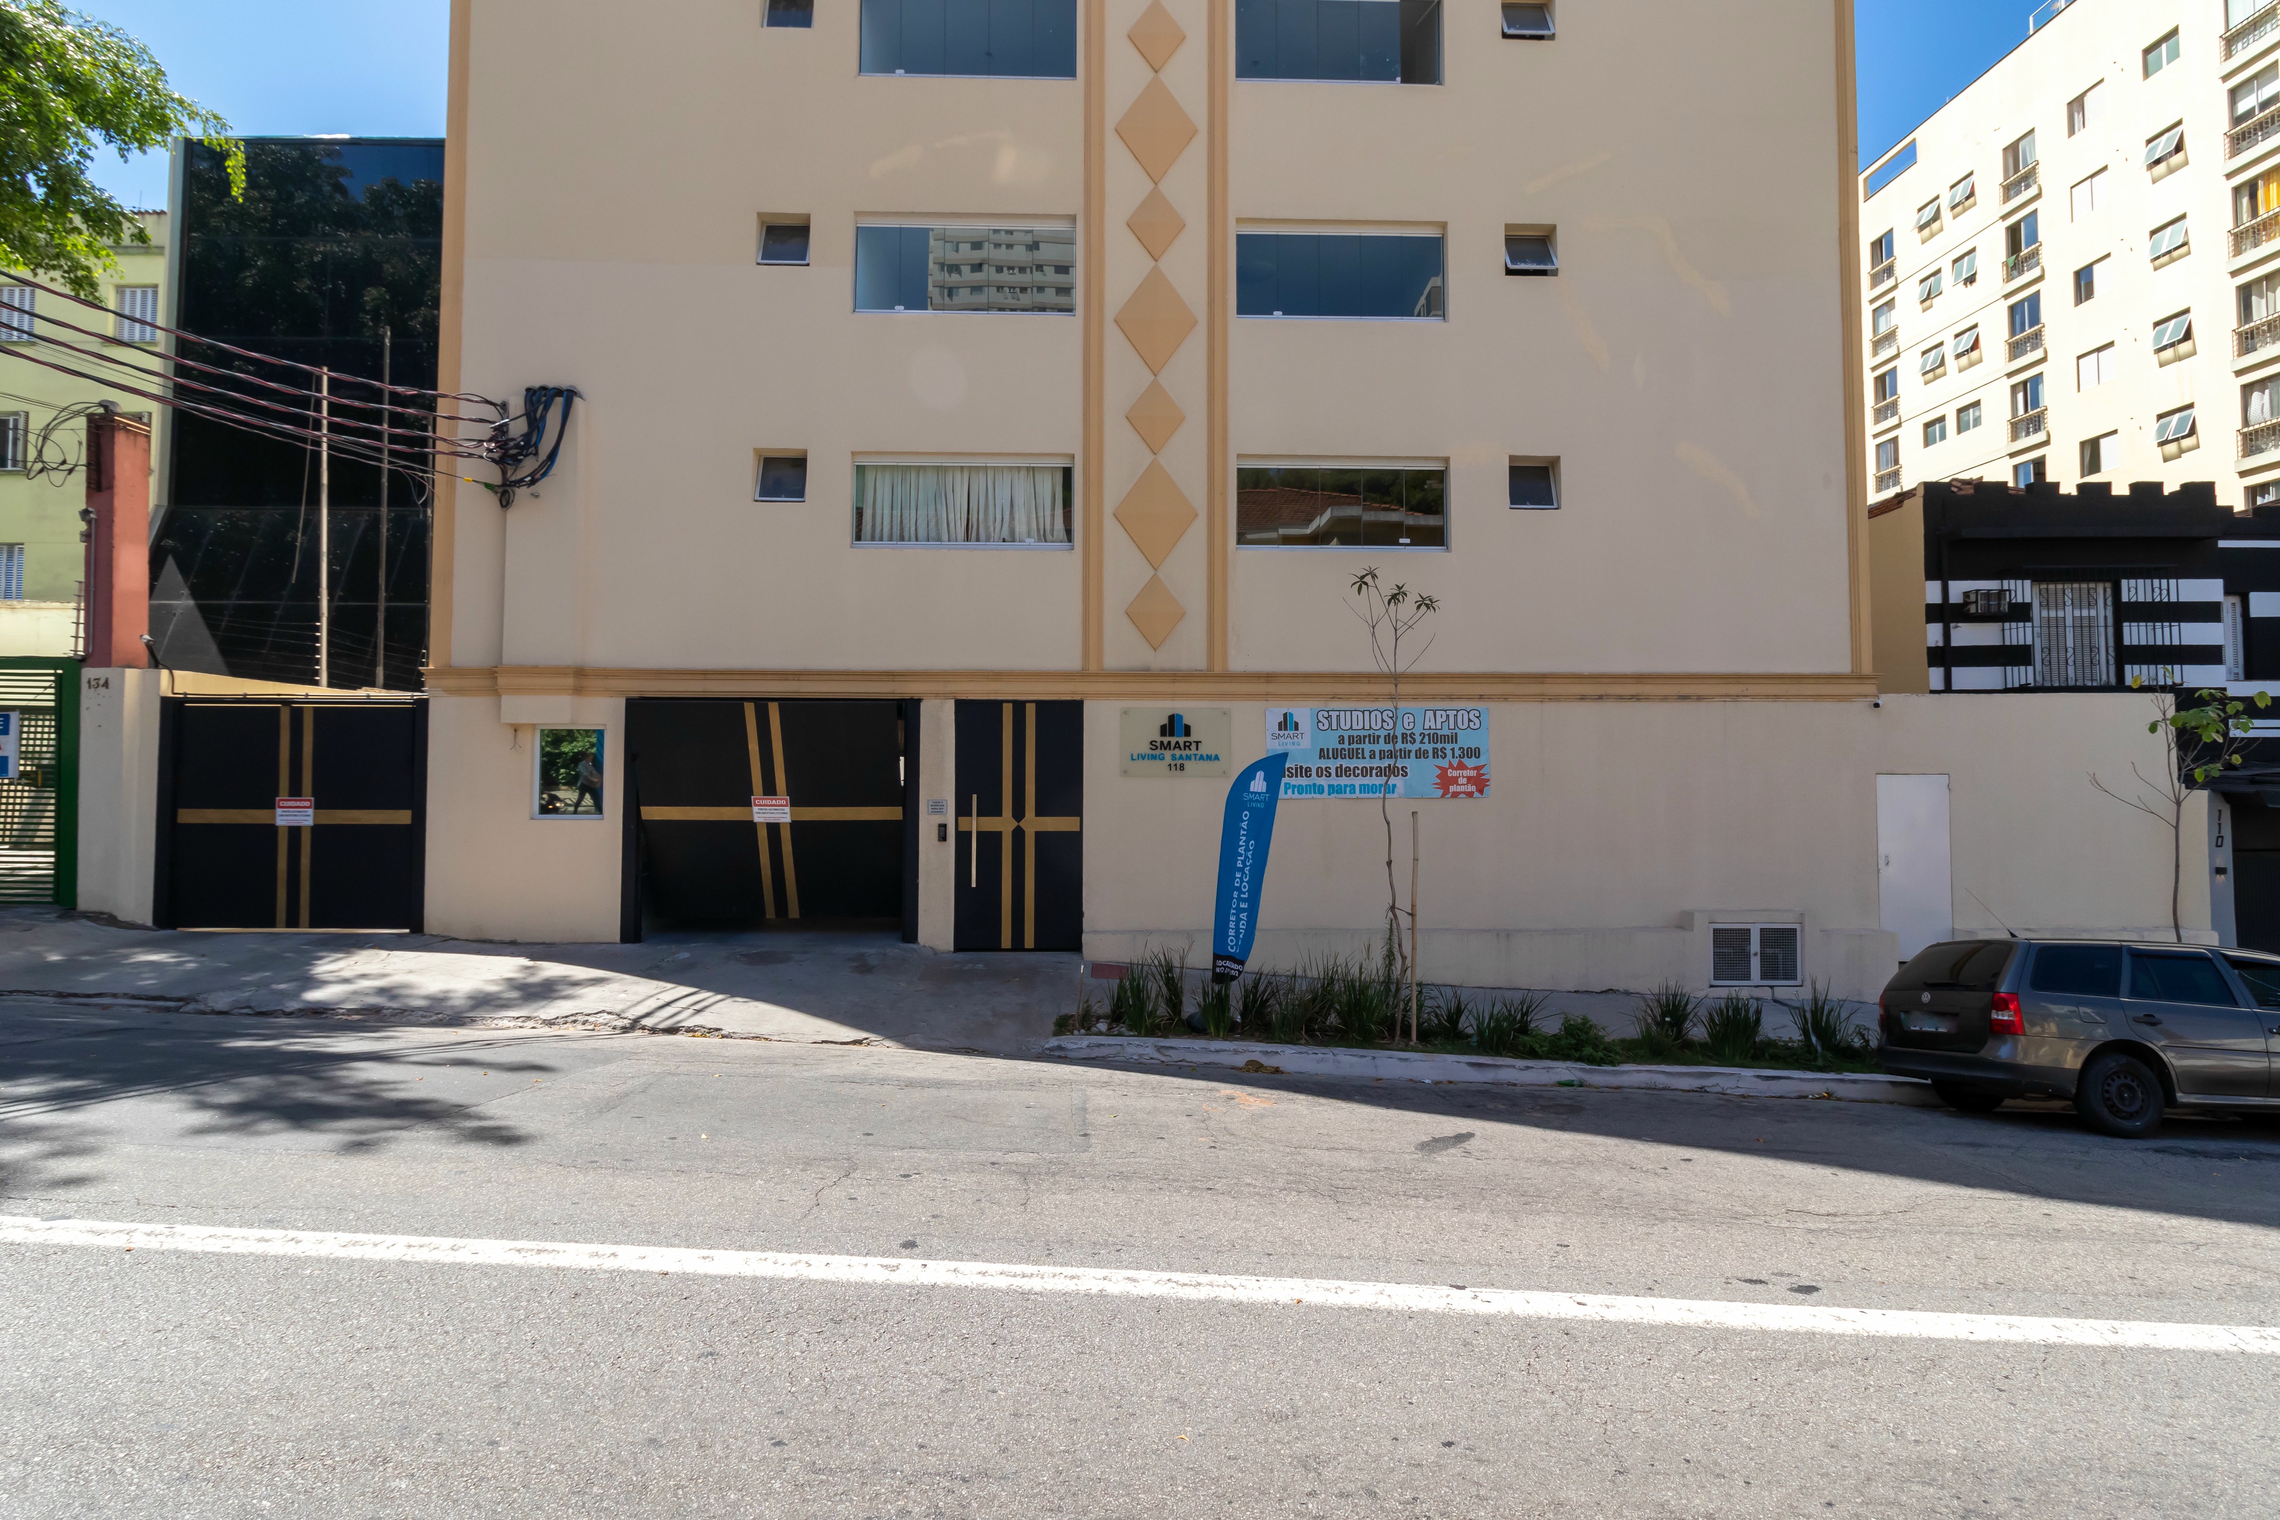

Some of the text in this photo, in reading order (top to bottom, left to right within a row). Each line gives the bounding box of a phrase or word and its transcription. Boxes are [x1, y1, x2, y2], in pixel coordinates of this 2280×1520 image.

[1316, 709, 1482, 731] STUDIOS e APTOS
[1271, 732, 1305, 740] SMART
[1338, 732, 1458, 746] a partir de R$ 210mil
[1149, 740, 1202, 751] SMART
[1130, 752, 1220, 761] LIVING SANTANA
[1318, 746, 1481, 761] ALUGUEL a partir de R$ 1.300
[1167, 763, 1185, 771] 118
[1283, 763, 1408, 779] site os decorados
[1458, 776, 1467, 784] de
[1283, 782, 1397, 796] Pronto para morar
[1449, 784, 1476, 792] plantão
[1243, 792, 1271, 801] SMART
[2215, 809, 2224, 848] 110
[1240, 840, 1255, 898] LOCAÇÃO
[1227, 810, 1250, 953] CORRETOR DE PLANTÃO
